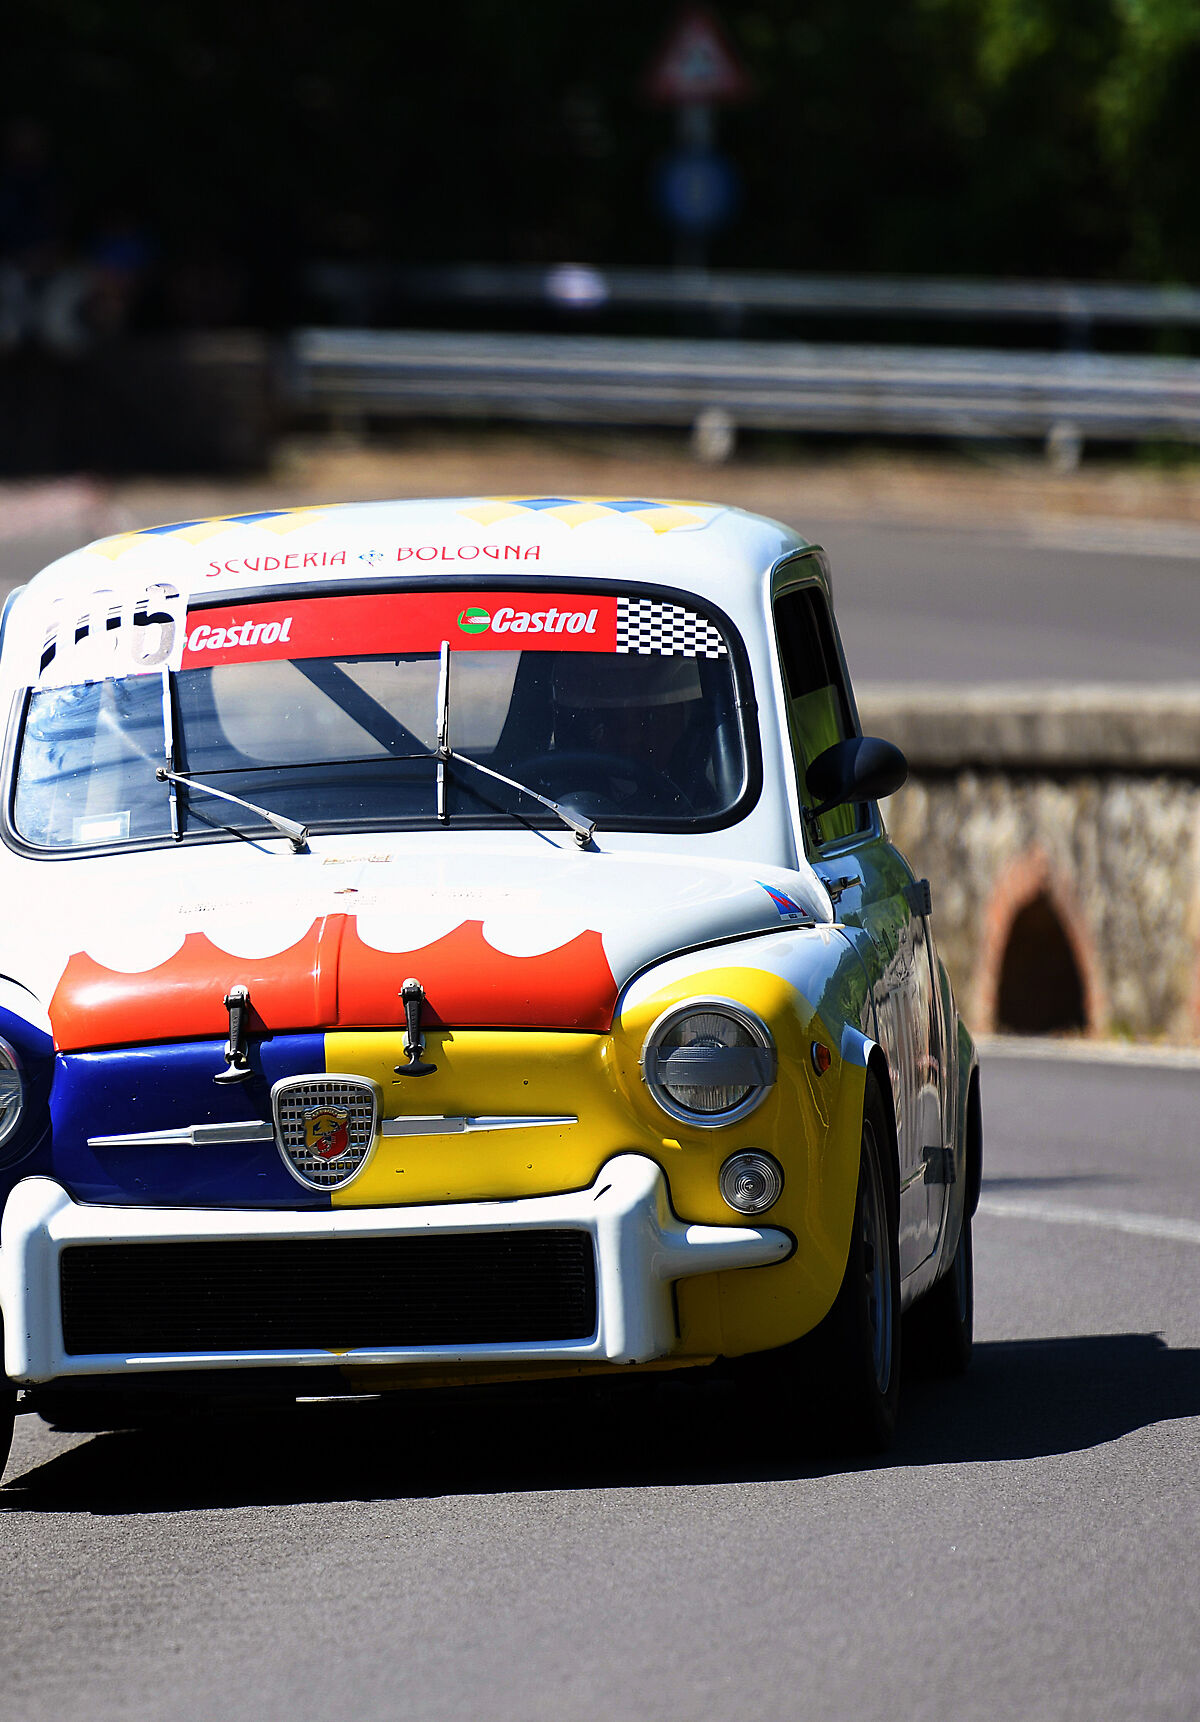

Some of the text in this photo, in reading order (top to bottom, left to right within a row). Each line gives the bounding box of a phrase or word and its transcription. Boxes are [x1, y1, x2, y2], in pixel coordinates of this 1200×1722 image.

[204, 544, 542, 578] SCUDERIA BOLOGNA
[185, 616, 293, 652] Castrol
[490, 607, 599, 634] Castrol
